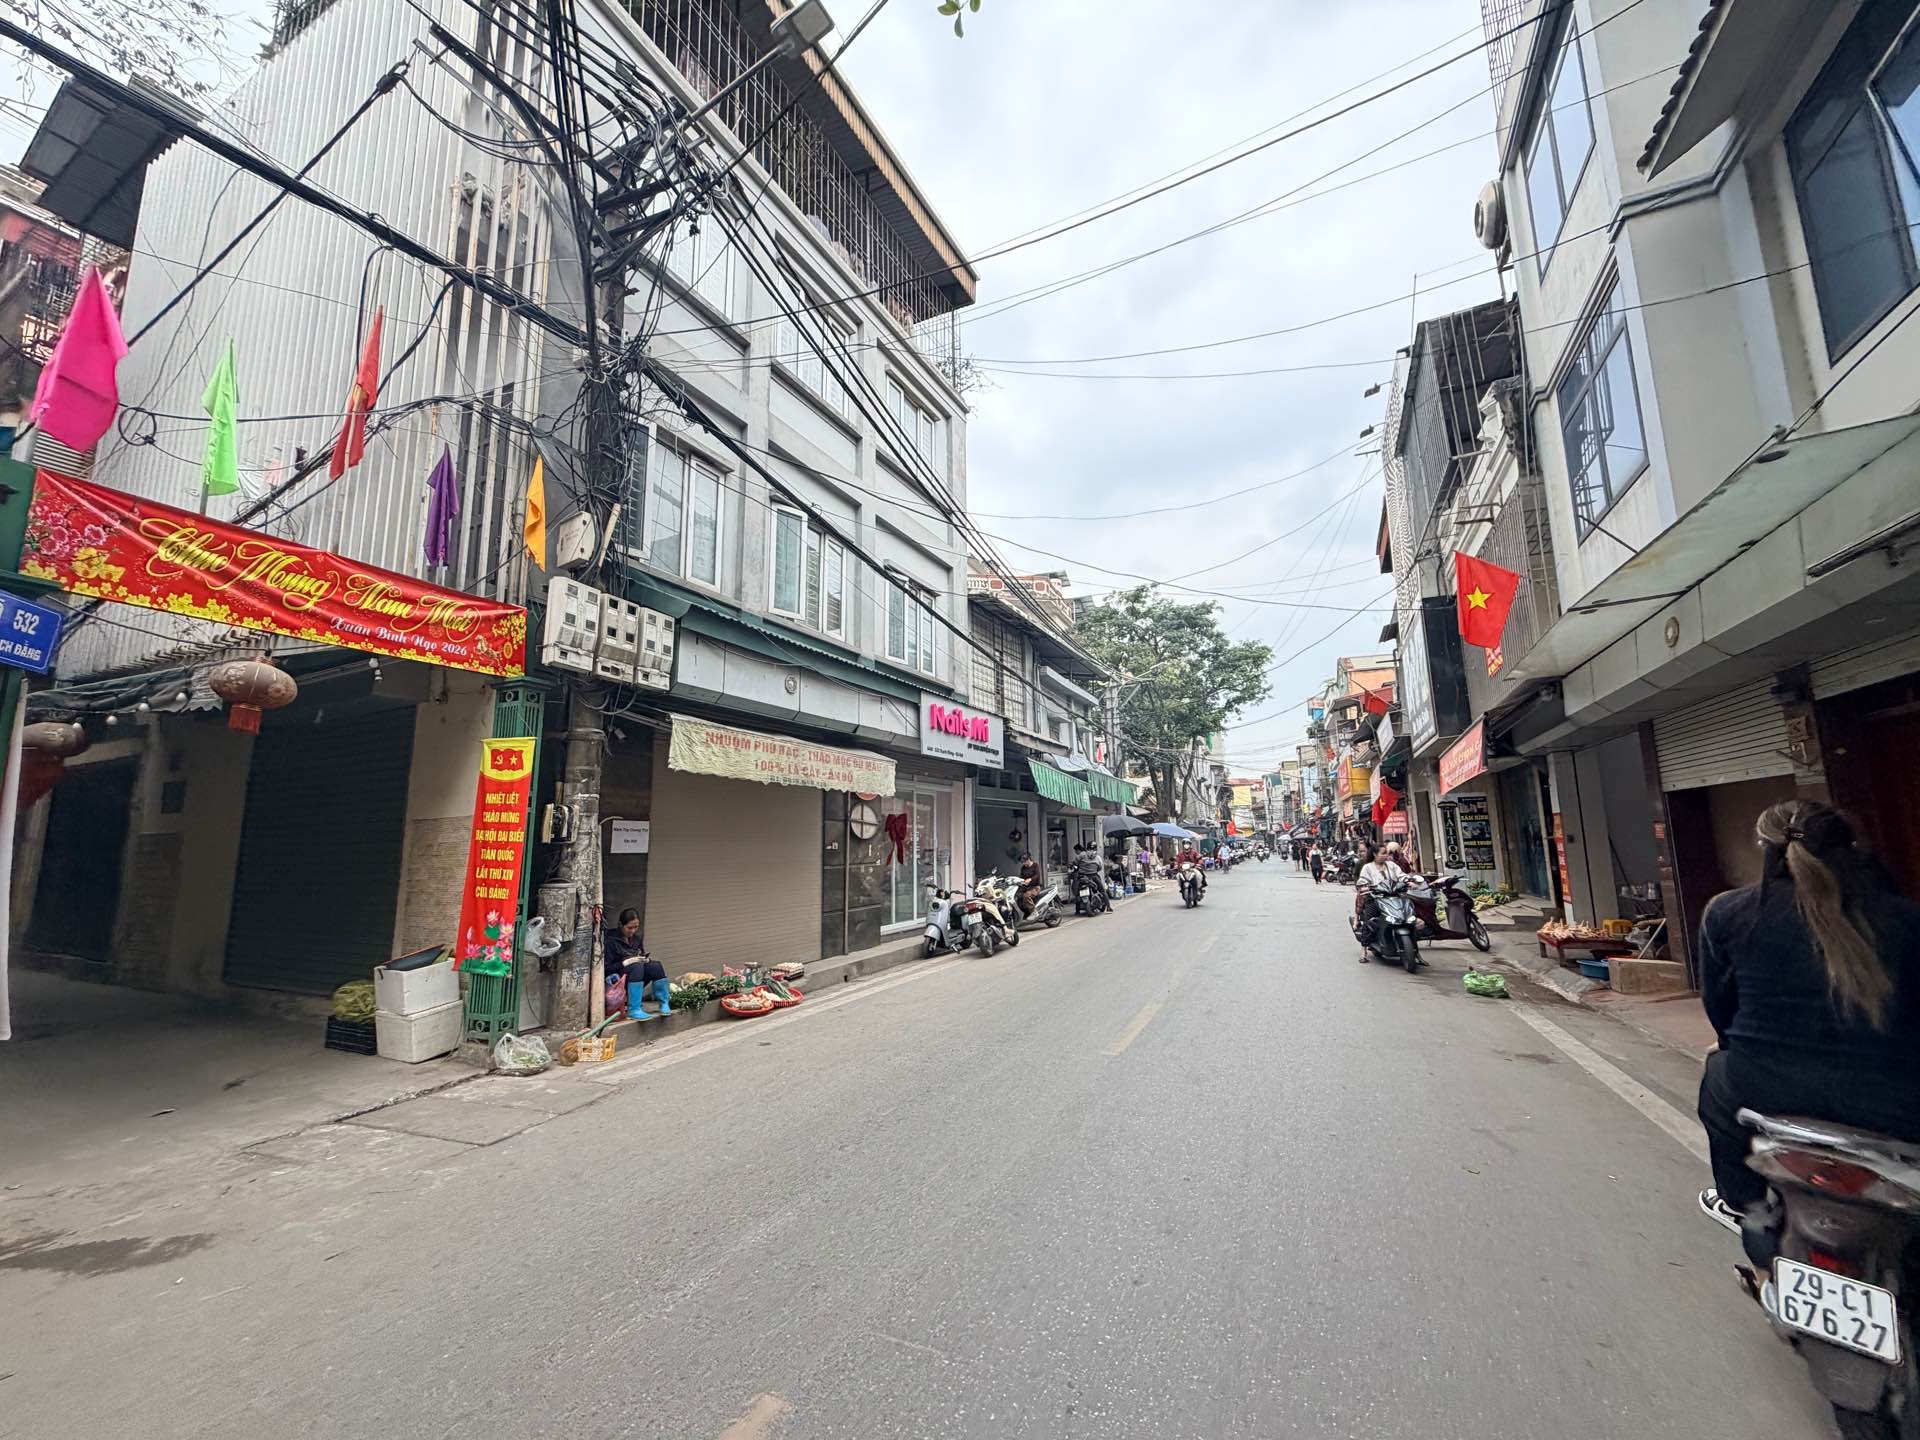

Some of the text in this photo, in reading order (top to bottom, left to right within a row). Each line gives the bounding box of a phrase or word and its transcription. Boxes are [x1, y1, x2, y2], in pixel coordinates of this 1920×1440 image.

[13, 609, 40, 635] 532
[441, 642, 467, 656] 2026
[930, 703, 990, 742] Nails Mi
[754, 760, 785, 773] 100%
[485, 792, 520, 807] NHIỆT LIỆT
[1444, 809, 1459, 862] TATTOO
[496, 846, 515, 861] QUỐC
[501, 869, 514, 880] XIV
[1792, 1268, 1873, 1318] 29-C1
[1784, 1295, 1887, 1351] 676.27
